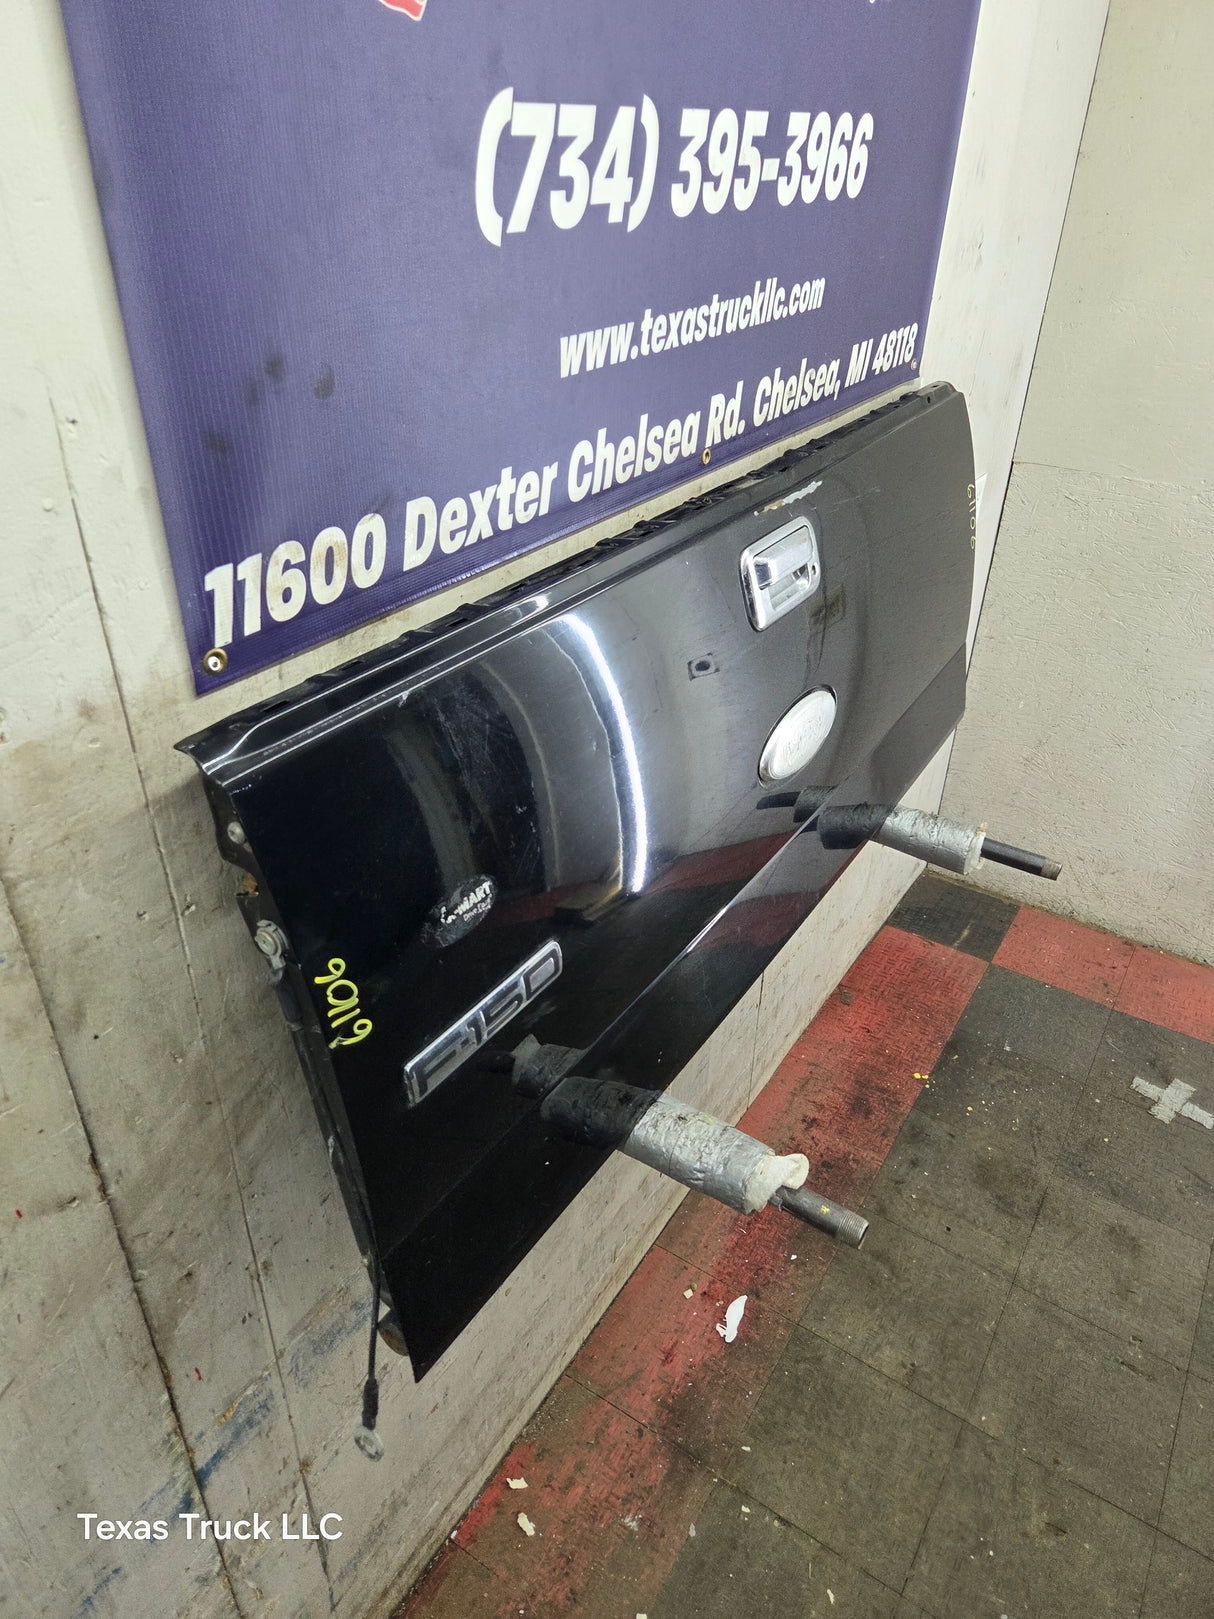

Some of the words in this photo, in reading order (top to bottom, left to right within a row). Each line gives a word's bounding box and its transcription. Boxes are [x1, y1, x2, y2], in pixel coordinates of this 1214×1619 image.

[475, 86, 660, 248] (734)
[671, 108, 874, 218] 395-3966
[559, 276, 826, 379] www.texastruckllc.com
[203, 512, 387, 650] 11600
[402, 461, 560, 573] Dexter
[566, 413, 701, 504] Chelsea
[705, 380, 746, 448] Rd.
[753, 357, 841, 428] Chelsea,
[844, 338, 874, 389] MI
[871, 322, 919, 376] 48118
